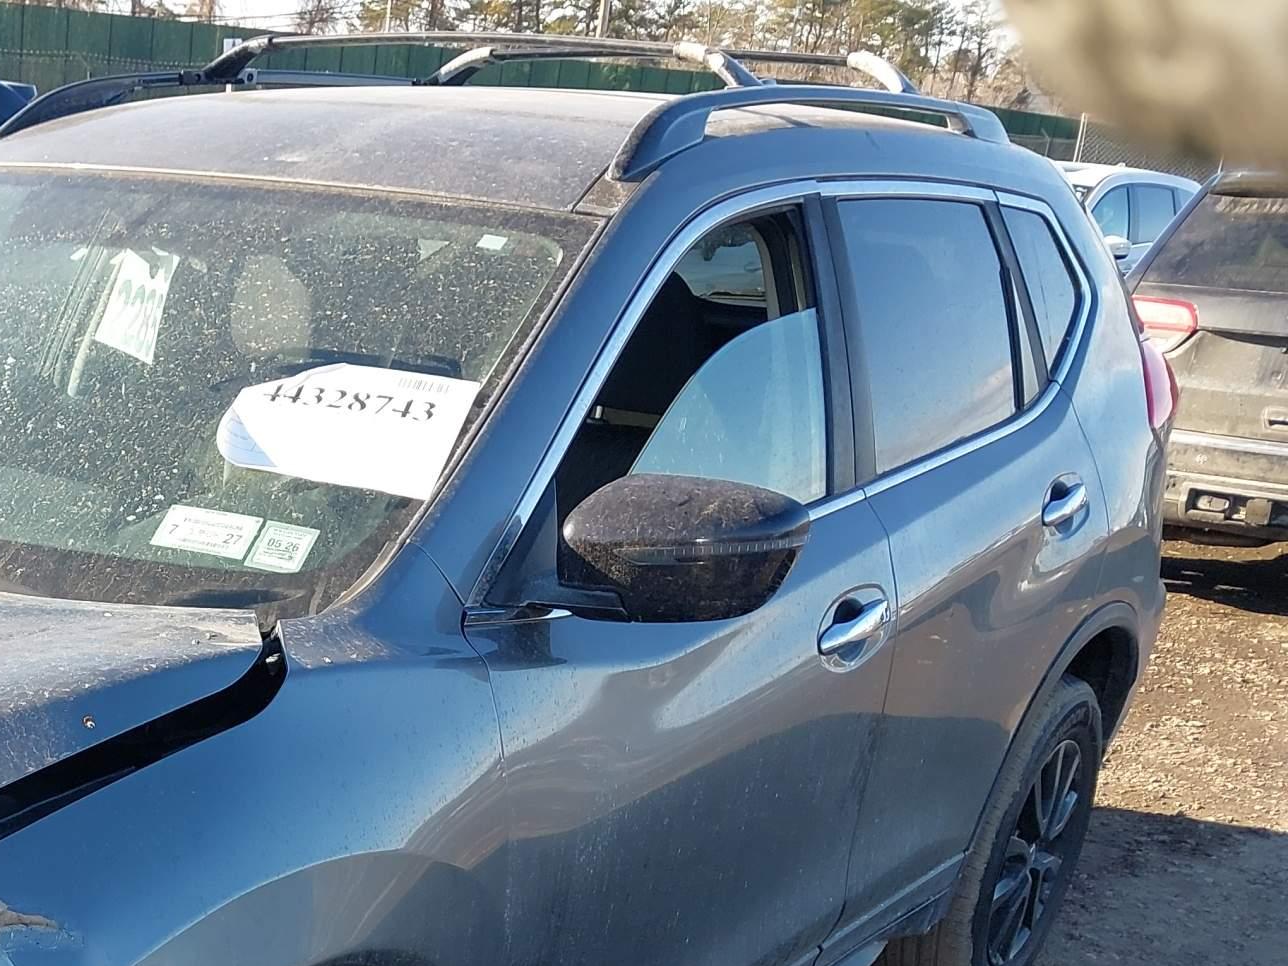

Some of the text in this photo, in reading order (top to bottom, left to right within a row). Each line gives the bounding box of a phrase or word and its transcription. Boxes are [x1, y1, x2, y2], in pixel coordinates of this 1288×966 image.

[264, 383, 437, 421] 44328743
[222, 532, 243, 546] 27
[266, 537, 301, 553] 05 26
